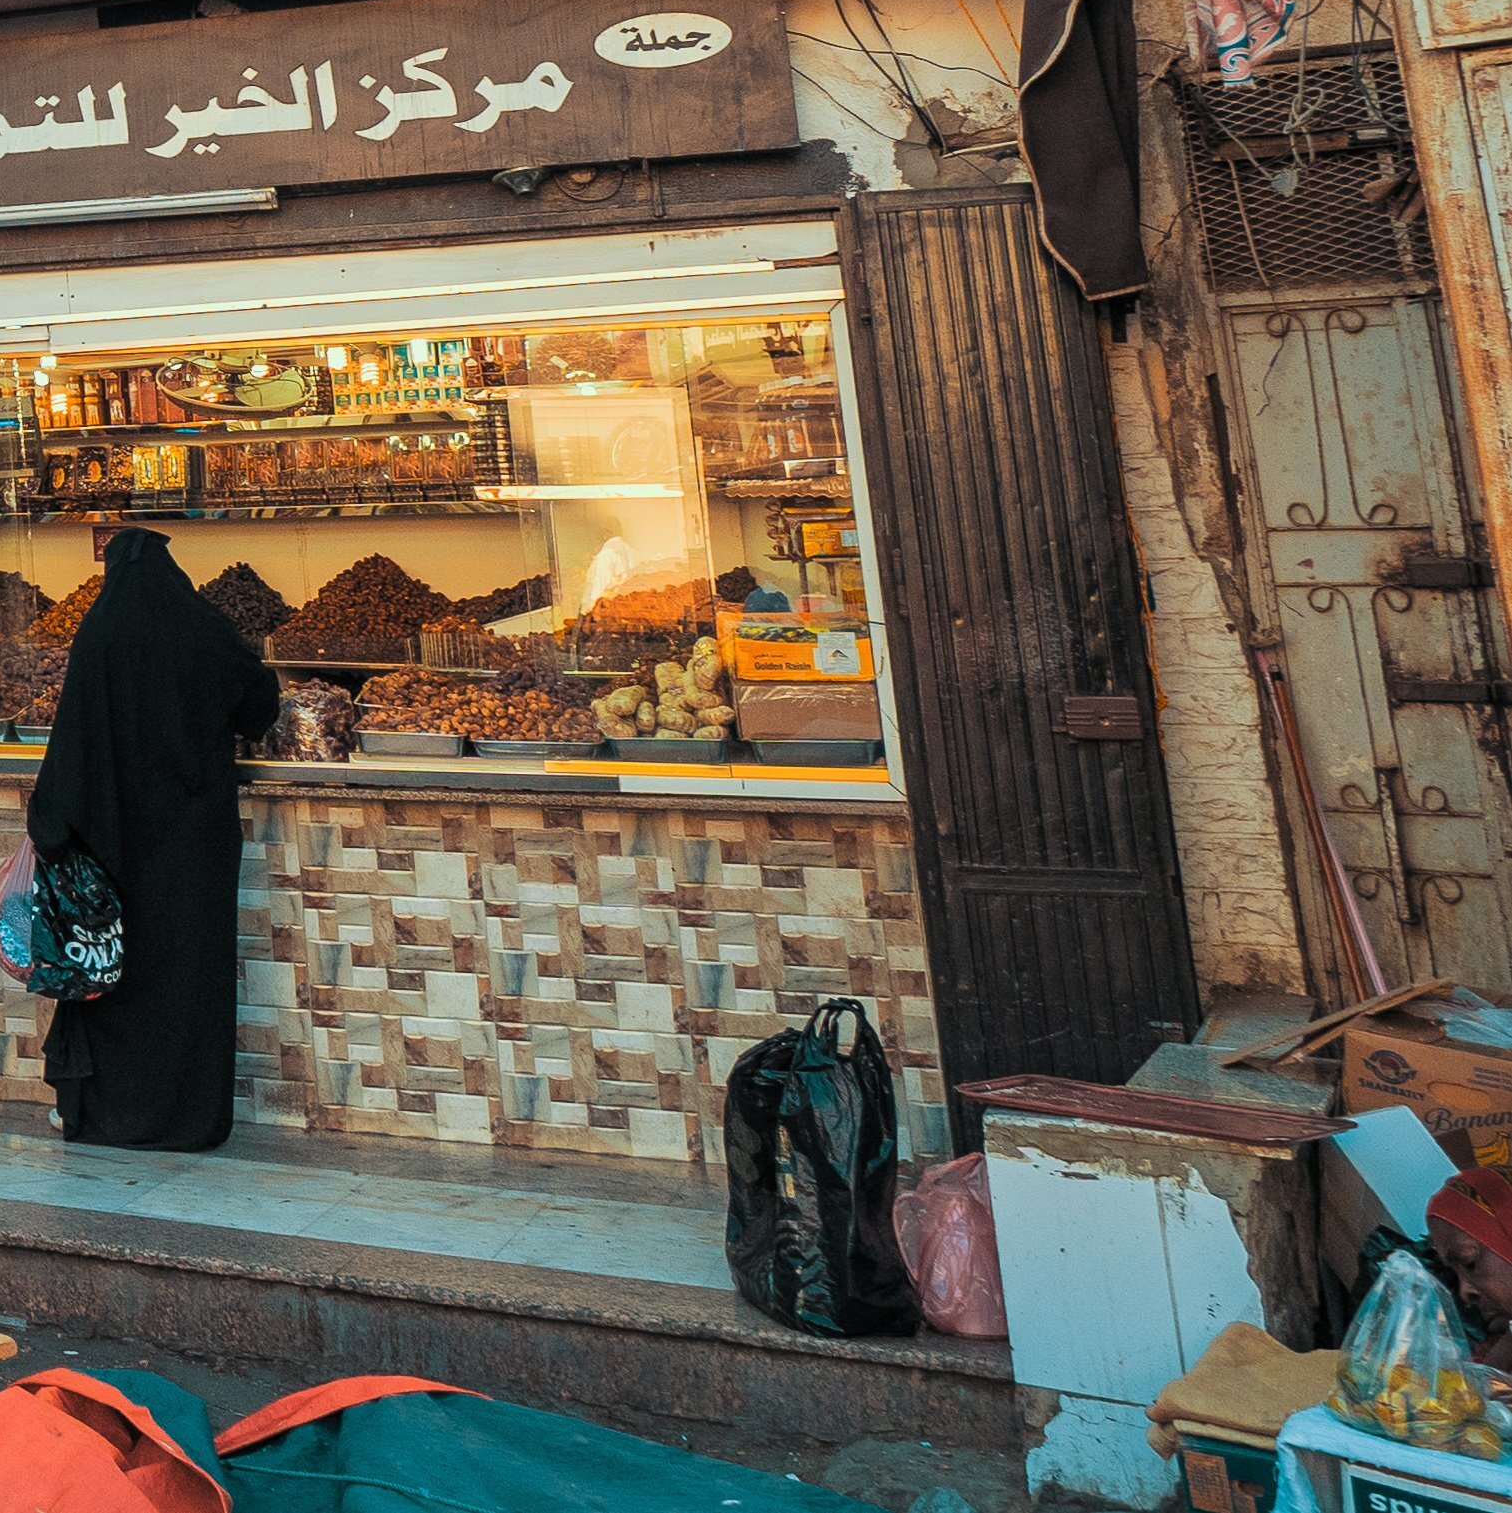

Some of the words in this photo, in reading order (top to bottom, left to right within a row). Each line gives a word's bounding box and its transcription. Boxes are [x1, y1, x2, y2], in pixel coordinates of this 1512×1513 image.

[619, 26, 712, 51] جملة
[144, 59, 338, 159] الخير
[355, 48, 574, 140] مركز
[754, 661, 783, 671] Golden
[786, 662, 812, 671] Raisin
